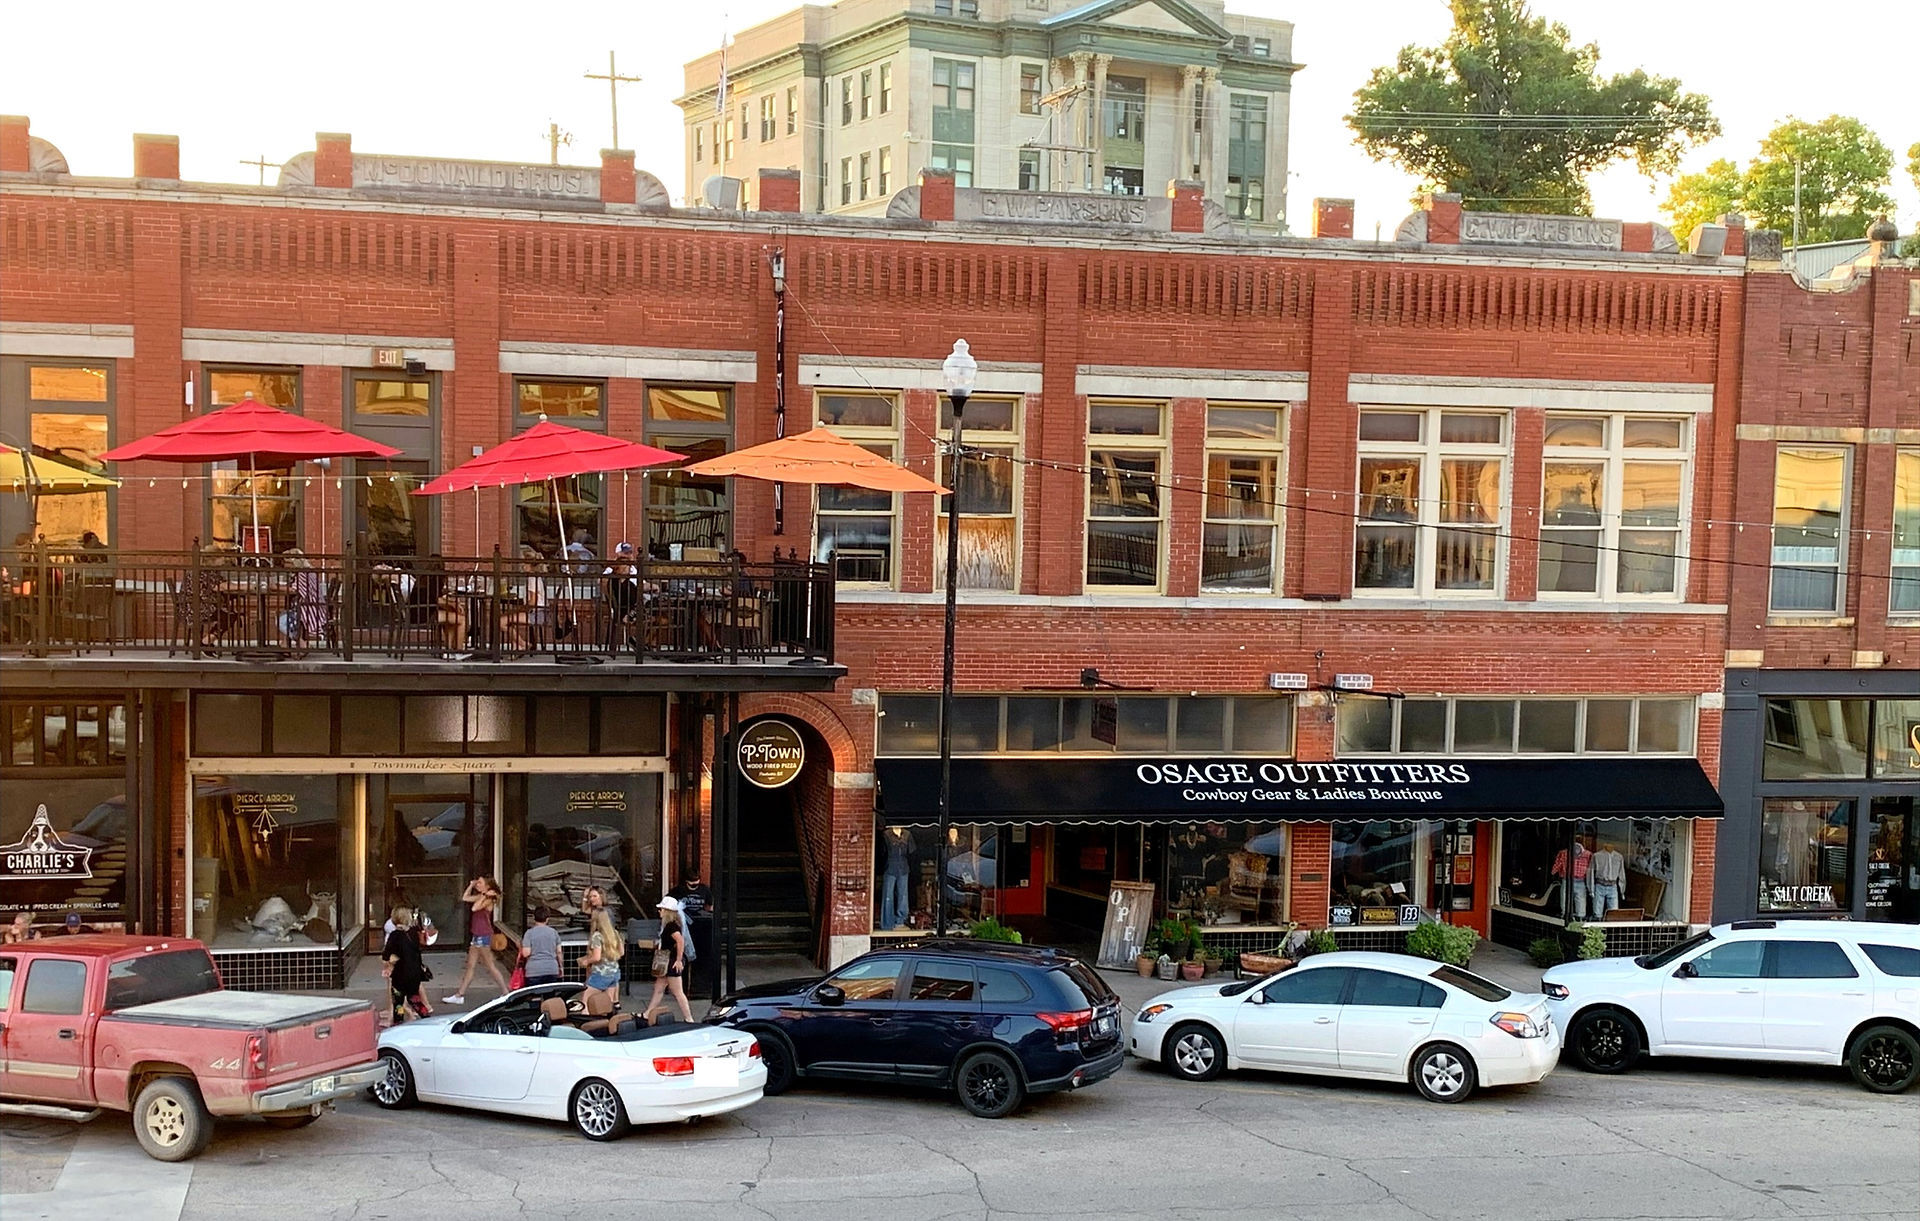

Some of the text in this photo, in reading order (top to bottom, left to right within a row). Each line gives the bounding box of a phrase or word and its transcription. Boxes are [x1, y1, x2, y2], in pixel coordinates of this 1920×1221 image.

[379, 350, 397, 364] EXIT
[1136, 763, 1471, 785] OSAGE OUTFITTERS
[569, 791, 625, 800] PIERCE ARROW
[1182, 787, 1444, 803] Cowboy Gear & Ladies Boutique
[7, 854, 75, 869] CHARLIE'S
[1774, 885, 1832, 902] SALT CREEK
